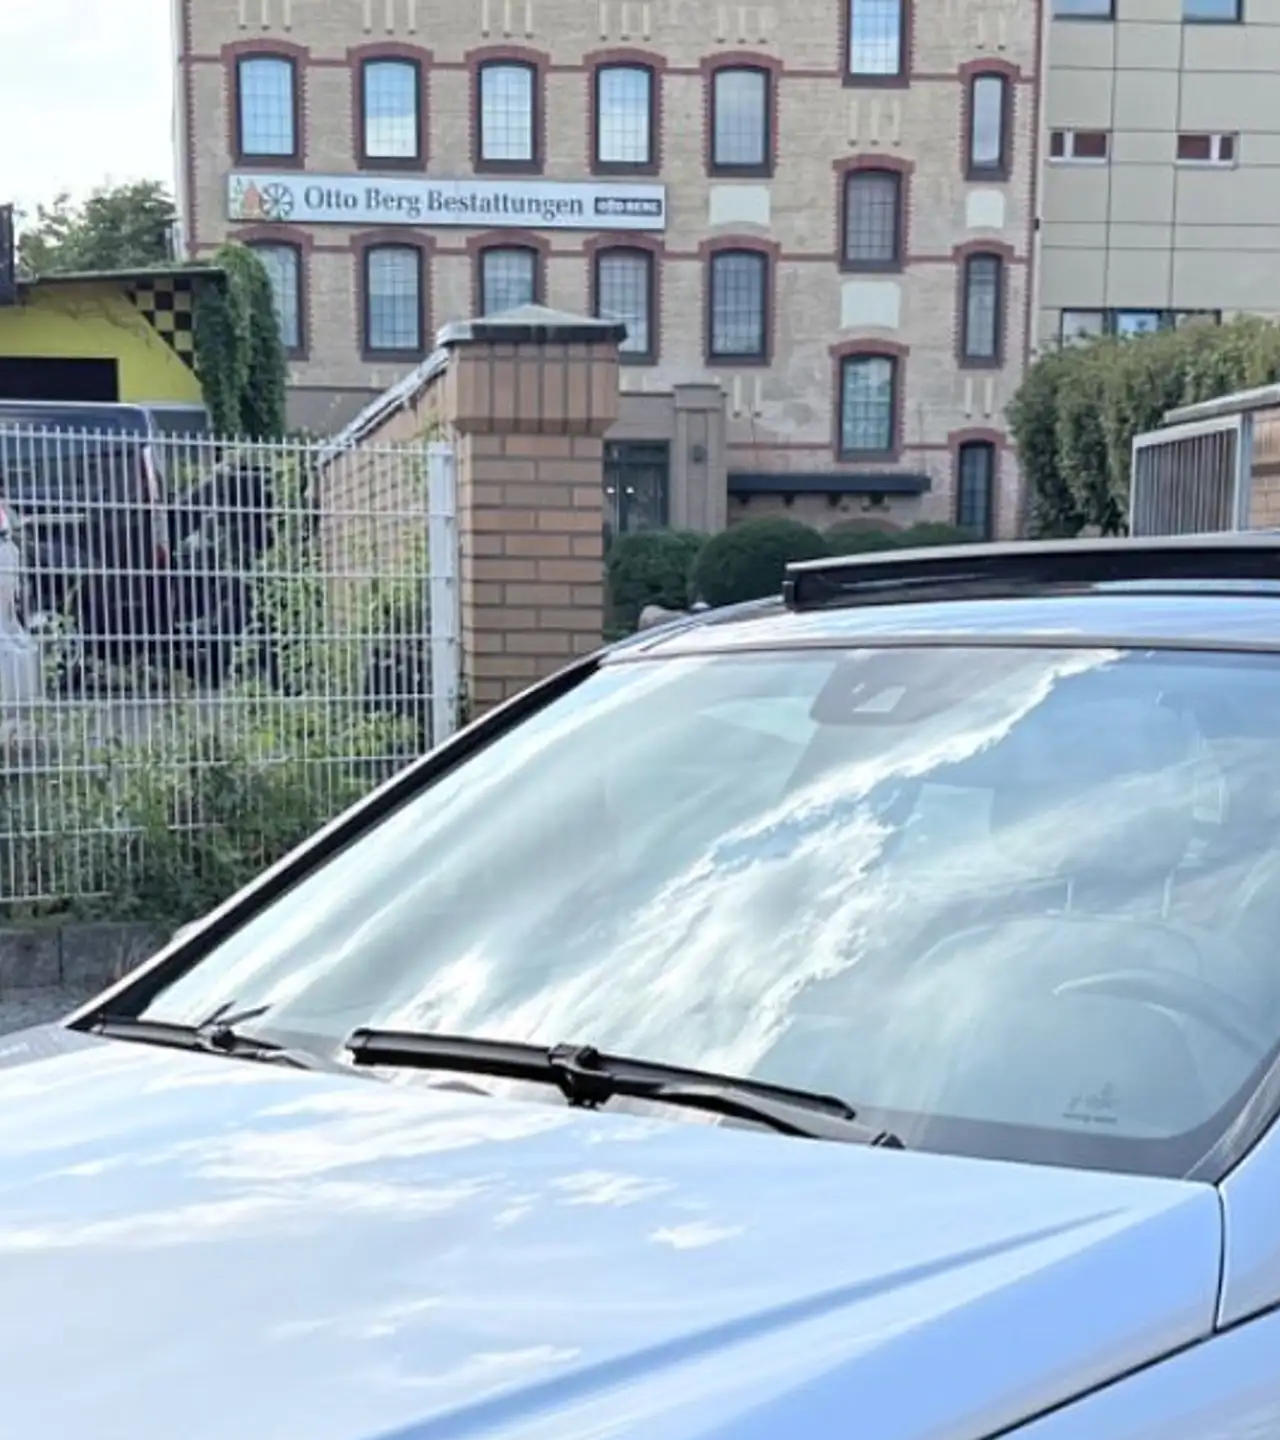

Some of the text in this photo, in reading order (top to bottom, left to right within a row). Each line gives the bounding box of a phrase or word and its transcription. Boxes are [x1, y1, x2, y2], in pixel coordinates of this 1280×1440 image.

[303, 185, 584, 222] Otto Berg Bestattungen
